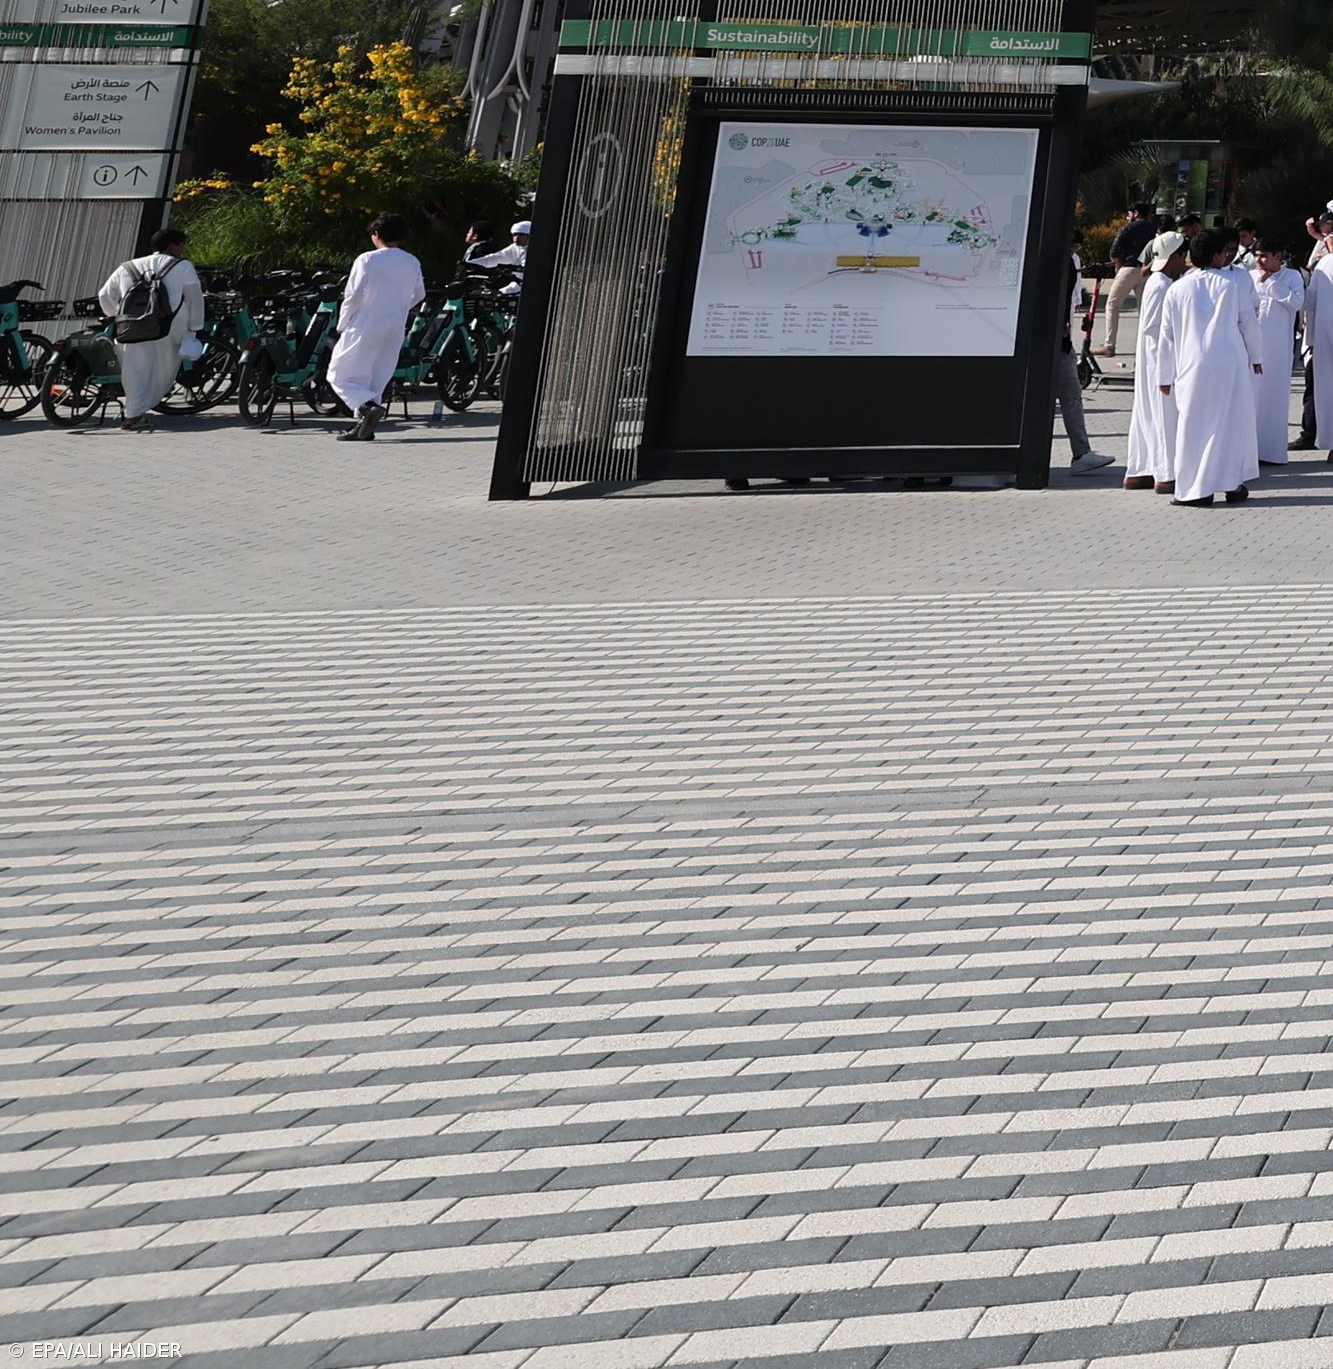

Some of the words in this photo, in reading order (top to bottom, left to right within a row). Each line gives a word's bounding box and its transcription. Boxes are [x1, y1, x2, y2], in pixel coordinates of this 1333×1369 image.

[61, 4, 108, 14] Jubilee
[110, 5, 141, 14] Park
[114, 31, 174, 42] الاستدامة
[706, 29, 819, 48] Sustainability
[990, 36, 1060, 51] الاستدامة
[71, 78, 101, 90] الأرض
[102, 79, 130, 89] منصة
[63, 93, 94, 102] Earth
[96, 93, 128, 103] Stage
[72, 111, 100, 123] المرأة
[101, 113, 124, 124] جناح
[24, 126, 75, 135] Women's
[78, 126, 121, 135] Pavilion
